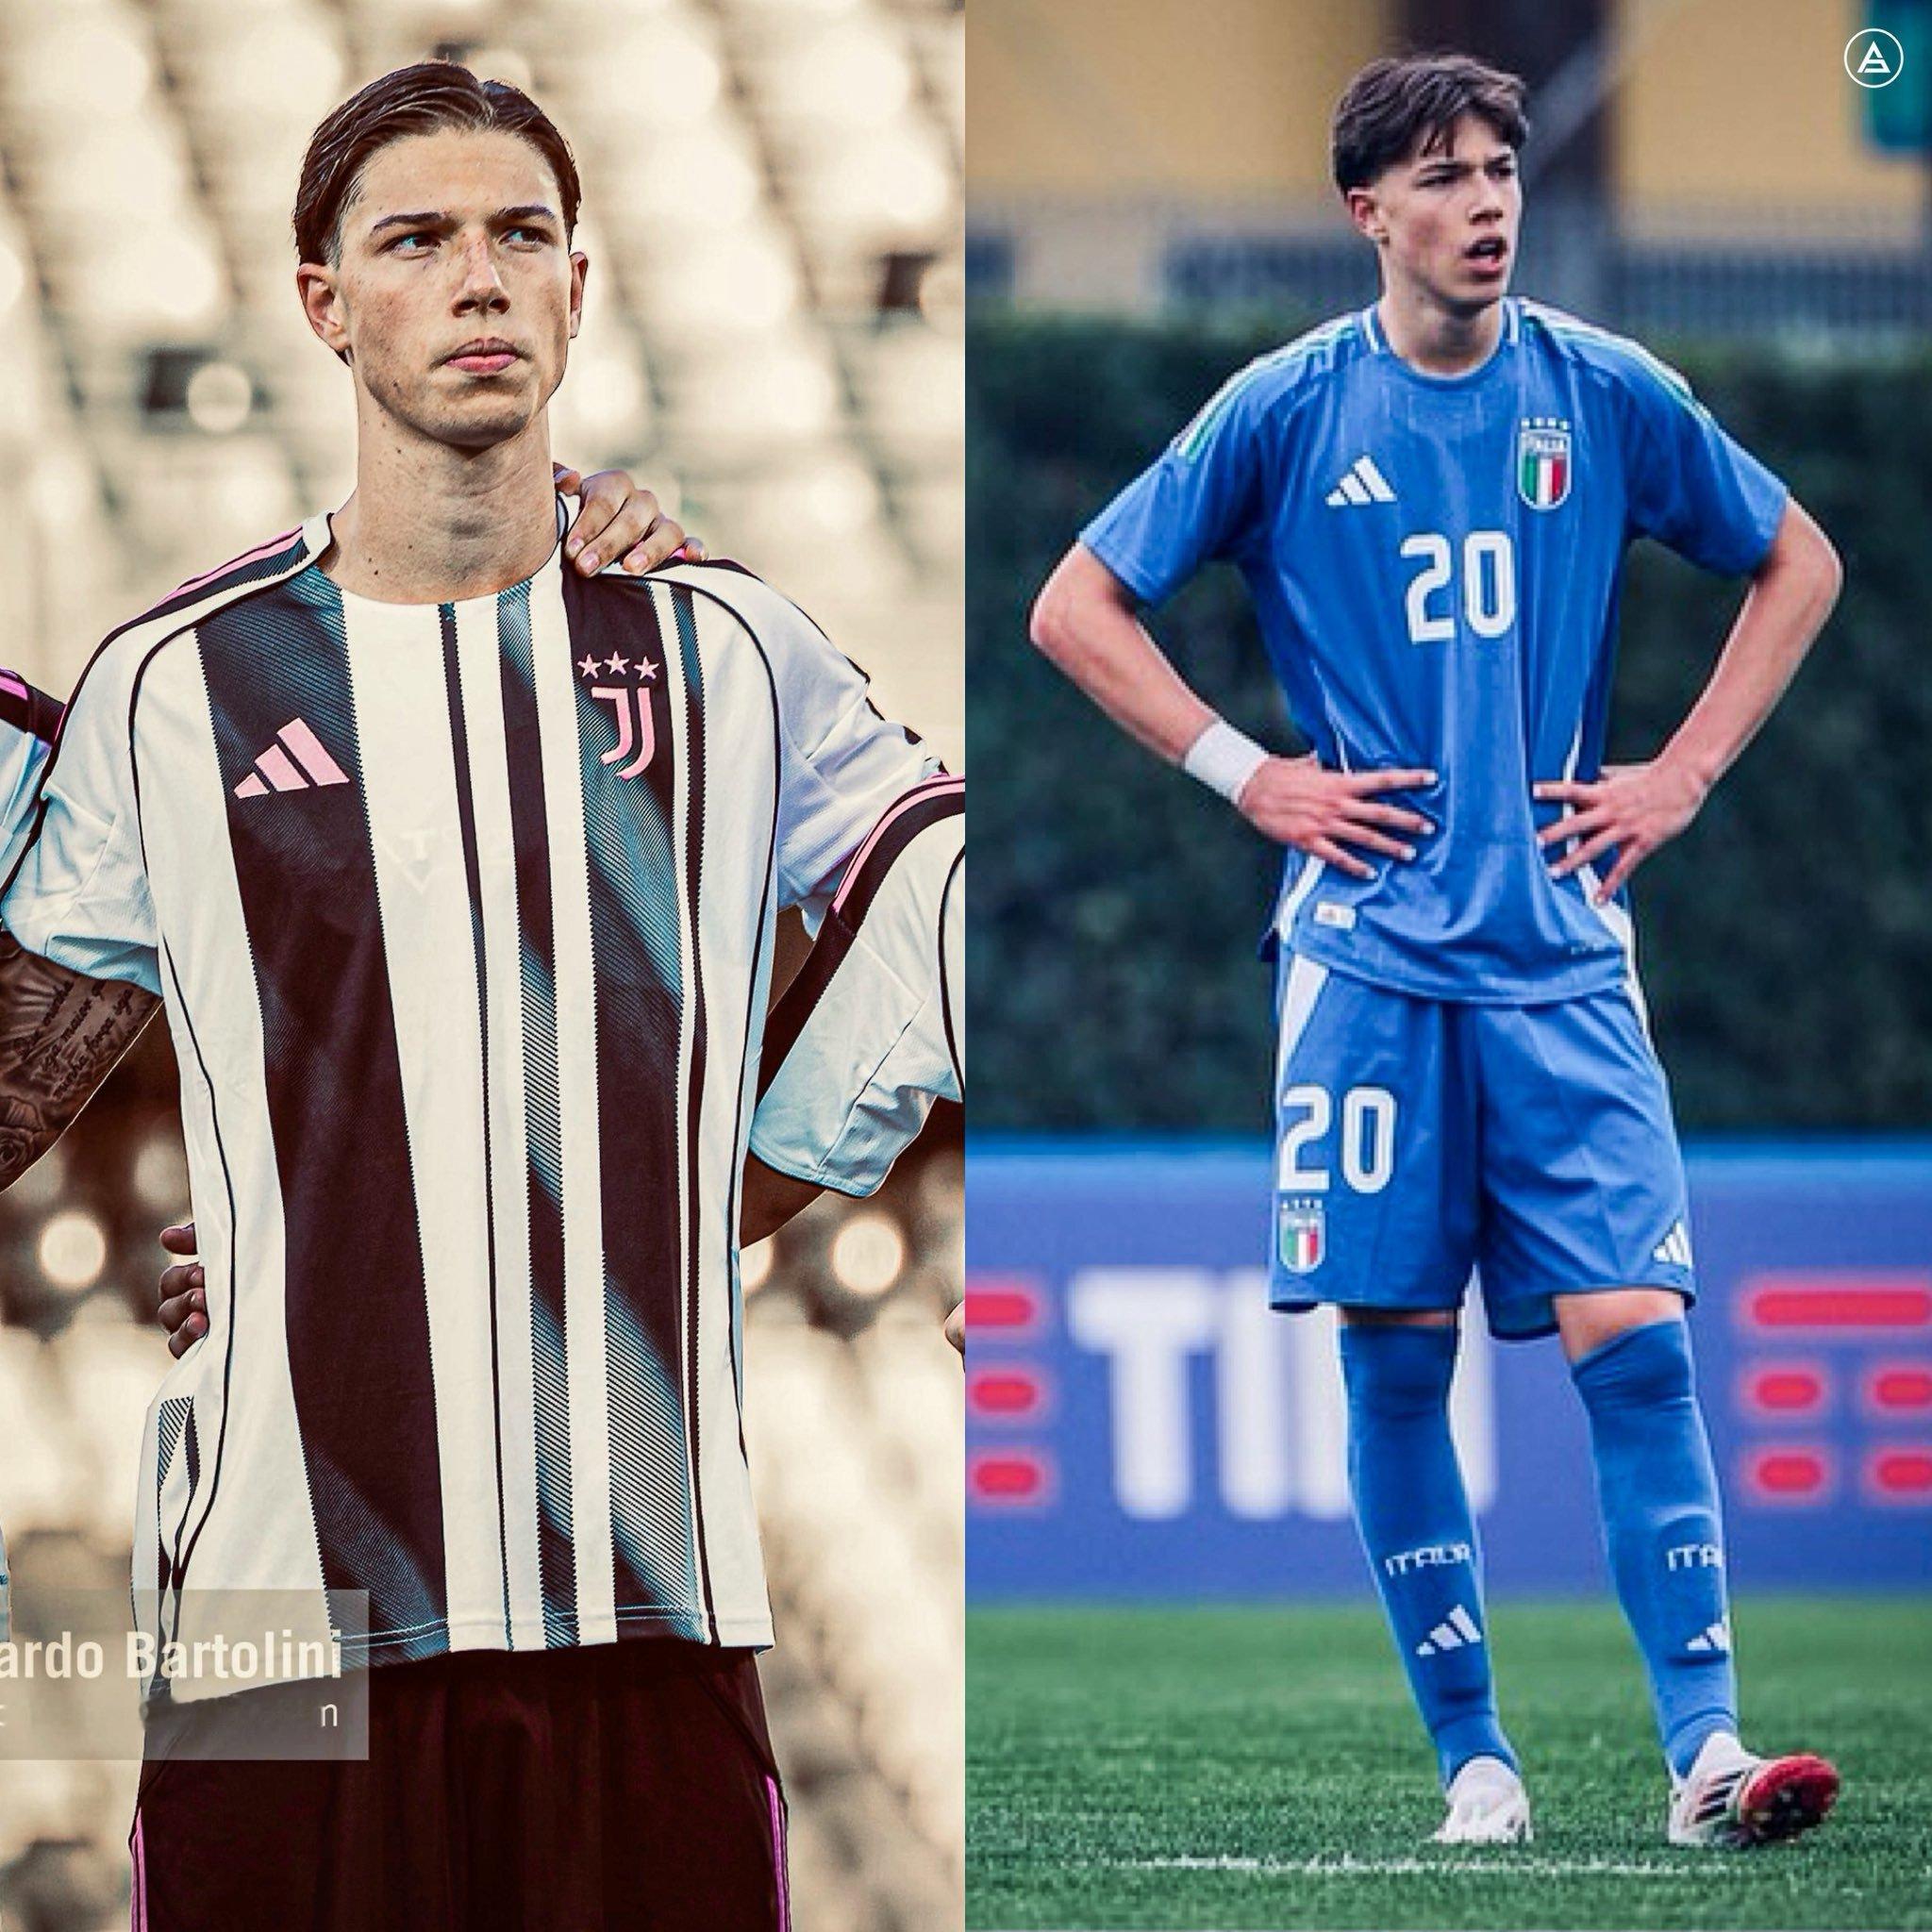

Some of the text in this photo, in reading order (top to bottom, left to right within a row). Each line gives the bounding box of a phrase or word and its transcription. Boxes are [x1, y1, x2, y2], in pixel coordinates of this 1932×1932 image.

[1400, 531, 1515, 644] 20
[59, 998, 92, 1041] maior
[1278, 1086, 1395, 1193] 20
